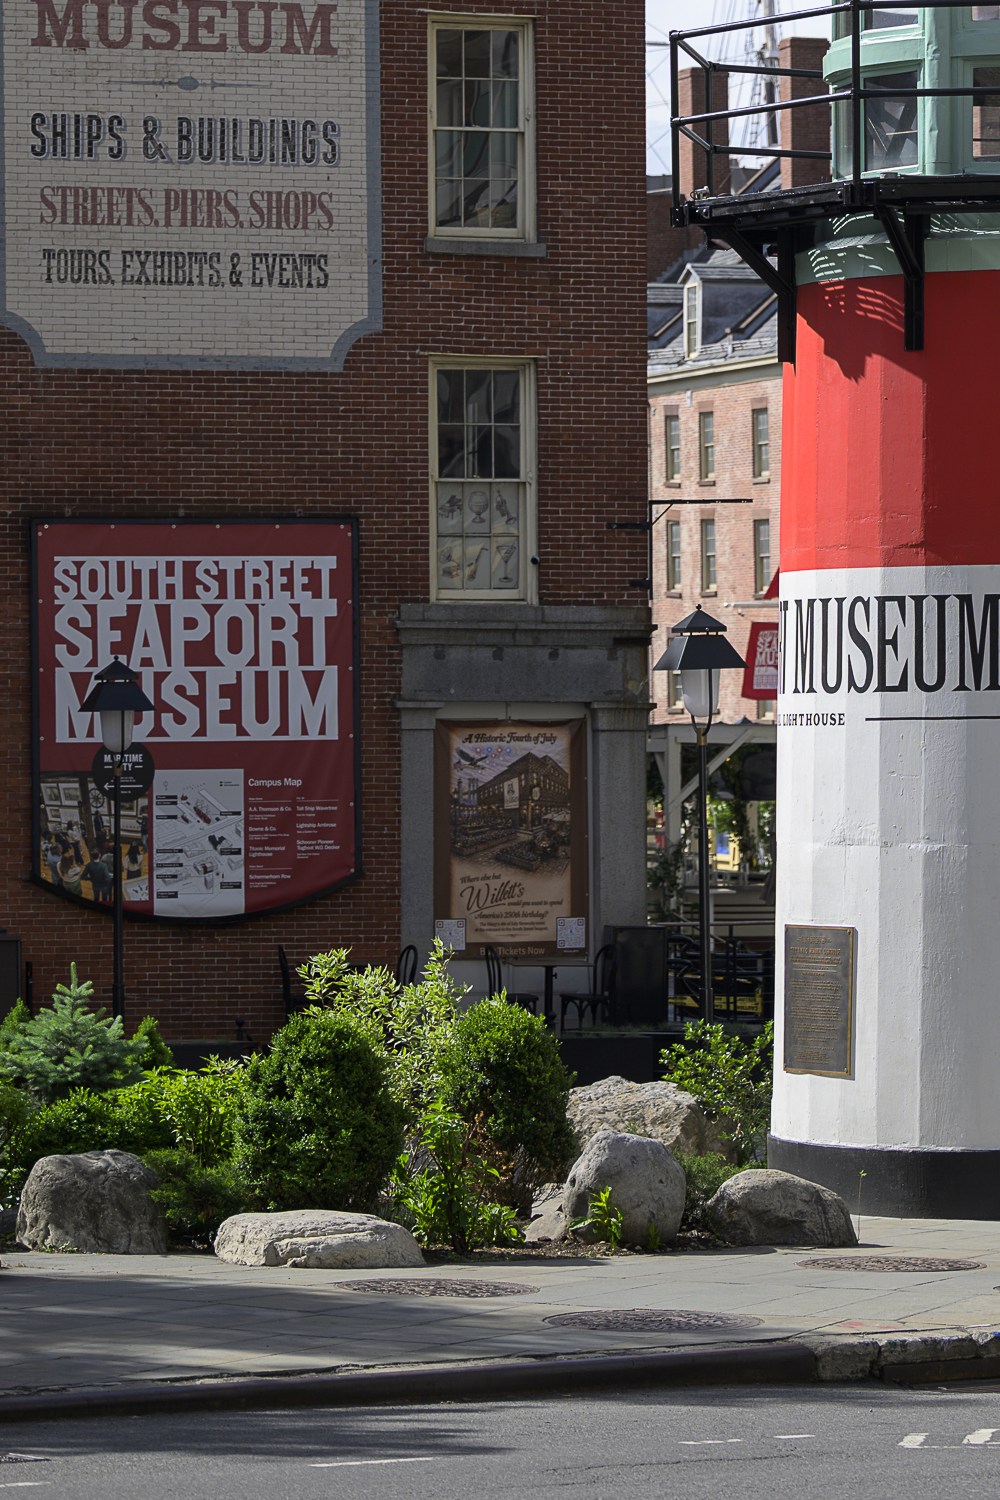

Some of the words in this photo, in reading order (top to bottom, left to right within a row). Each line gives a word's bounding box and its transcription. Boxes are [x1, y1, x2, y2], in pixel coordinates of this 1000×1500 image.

[30, 112, 126, 161] SHIPS
[142, 115, 170, 163] &
[177, 116, 340, 167] BUILDINGS
[250, 190, 335, 232] SHOPS
[43, 248, 115, 286] TOURS,
[121, 249, 225, 288] EXHIBITS,
[228, 252, 243, 288] &
[251, 253, 330, 289] EVENTS
[53, 558, 184, 601] SOUTH
[195, 557, 337, 601] STREET
[54, 601, 338, 669] SEAPORT
[783, 713, 846, 726] LIGHTHOUSE
[462, 733, 474, 743] A
[474, 733, 507, 743] Historic
[506, 731, 532, 743] Fourth
[532, 733, 541, 745] of
[540, 733, 557, 745] July
[104, 753, 144, 763] MARTIME
[248, 778, 282, 788] Campus
[283, 777, 303, 788] Map
[459, 875, 480, 884] Where
[475, 911, 504, 920] America's
[504, 910, 521, 918] 250th
[521, 910, 549, 920] birthday?
[497, 946, 526, 955] Tickets
[527, 946, 546, 955] Now
